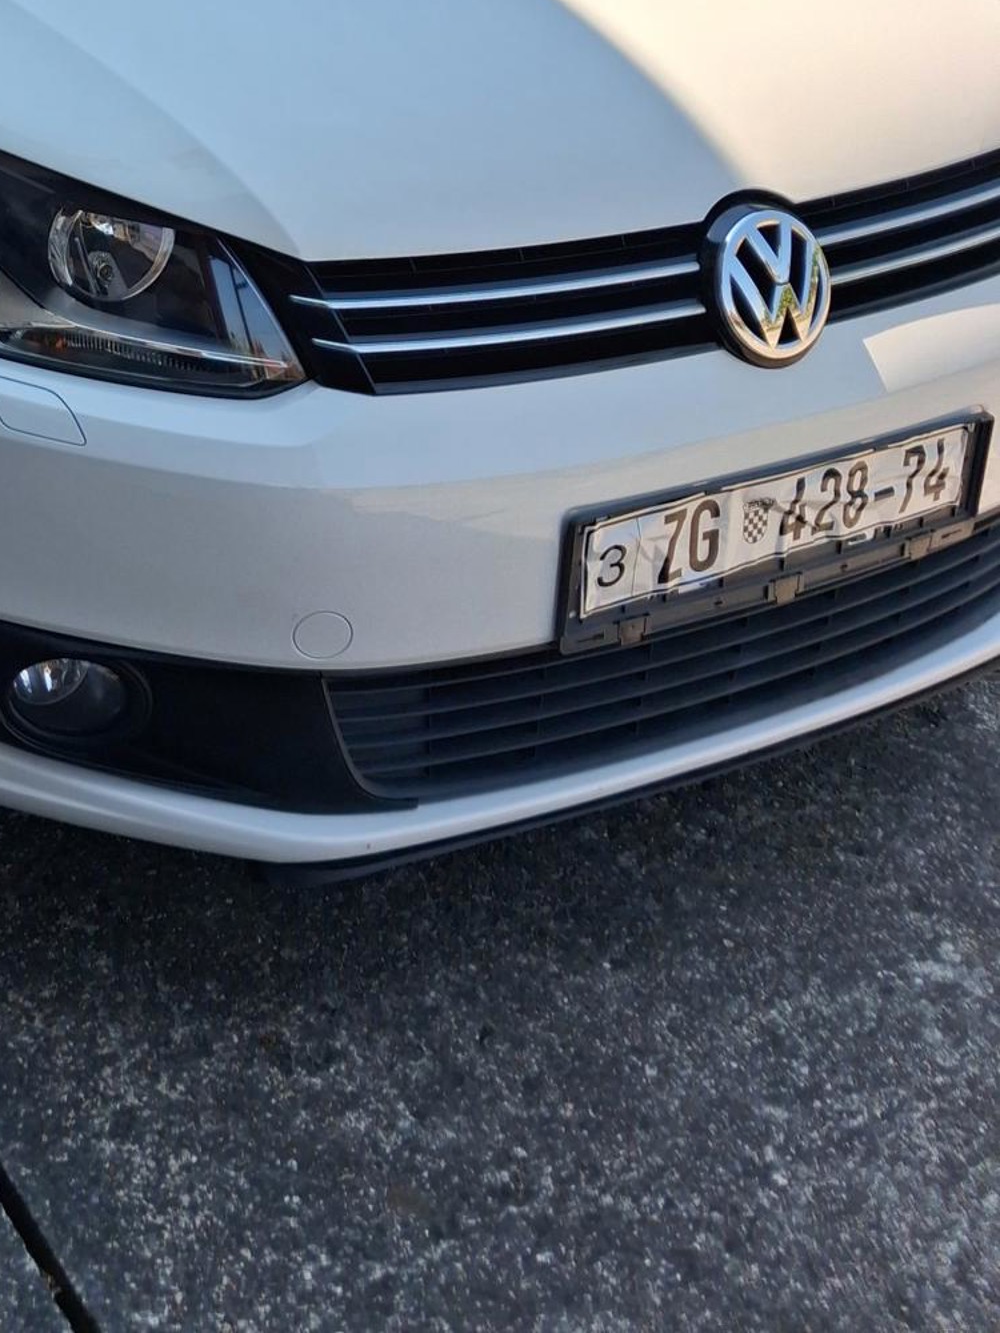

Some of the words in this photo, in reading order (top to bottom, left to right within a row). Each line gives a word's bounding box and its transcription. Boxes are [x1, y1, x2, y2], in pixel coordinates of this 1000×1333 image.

[723, 211, 827, 356] VW
[597, 544, 627, 587] 3
[657, 498, 721, 584] ZG
[779, 437, 950, 541] 428-74
